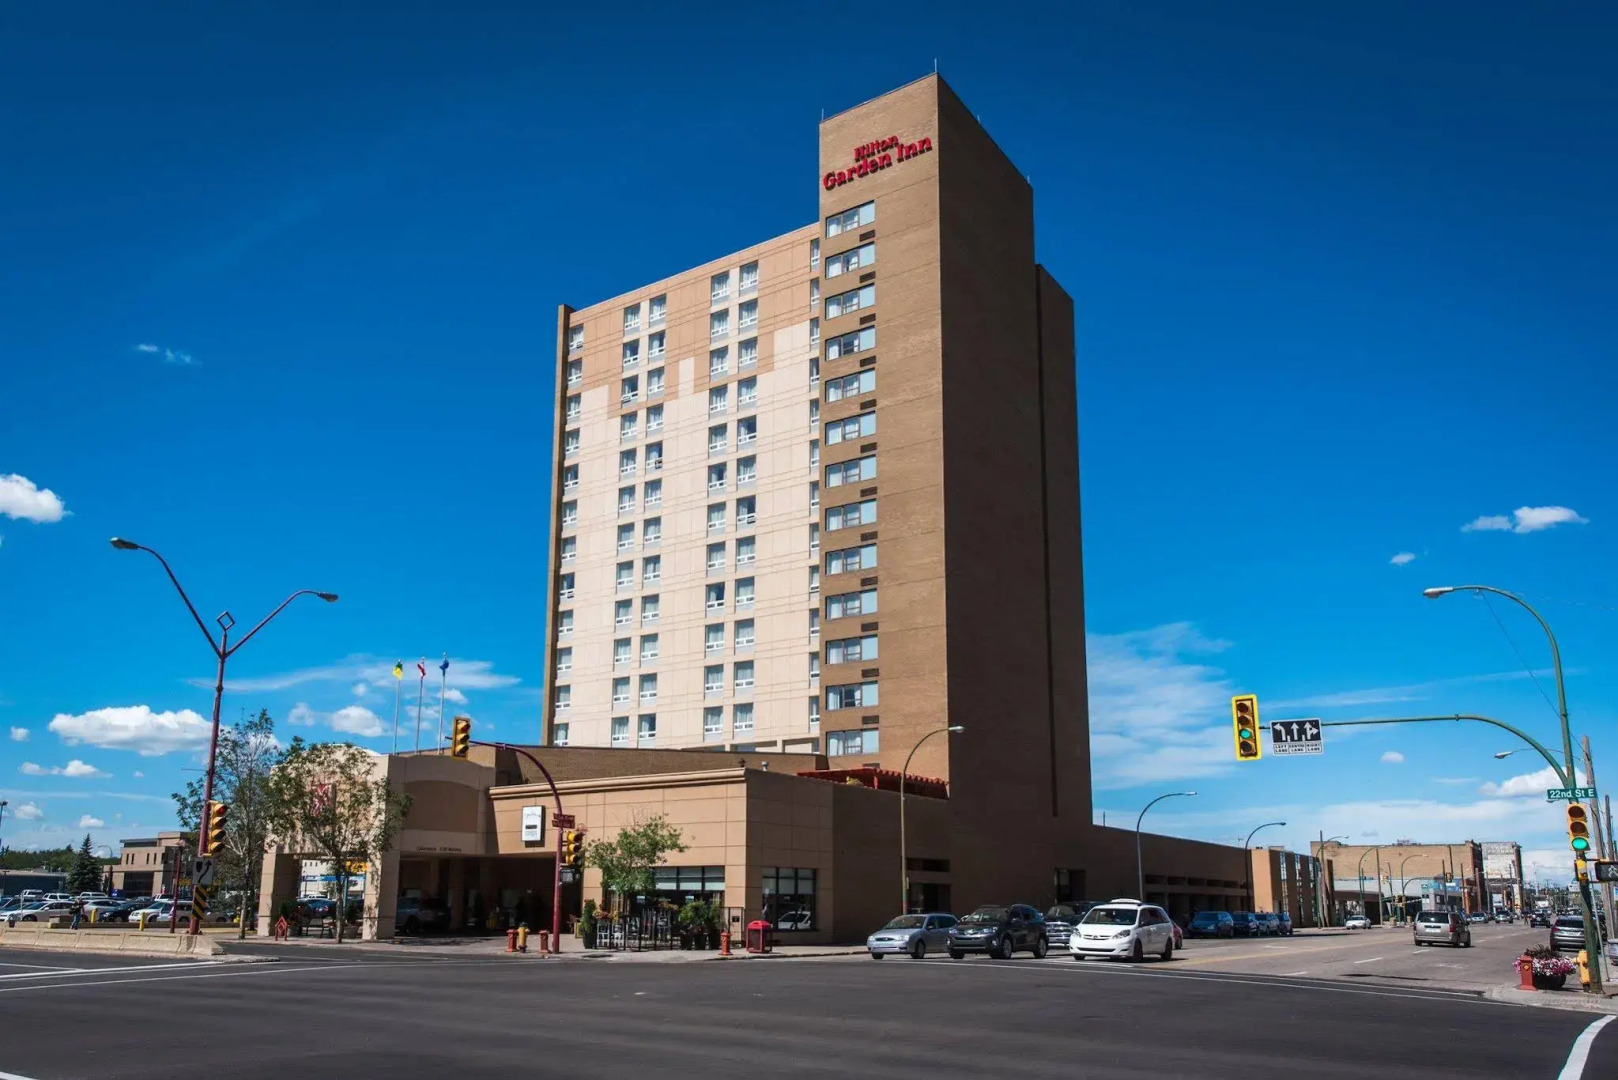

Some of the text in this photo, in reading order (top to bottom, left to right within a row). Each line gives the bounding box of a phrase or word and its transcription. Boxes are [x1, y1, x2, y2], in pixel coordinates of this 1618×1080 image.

[854, 135, 899, 162] Hilton
[823, 136, 933, 191] Garden Inn
[1549, 789, 1594, 798] 22nd St E
